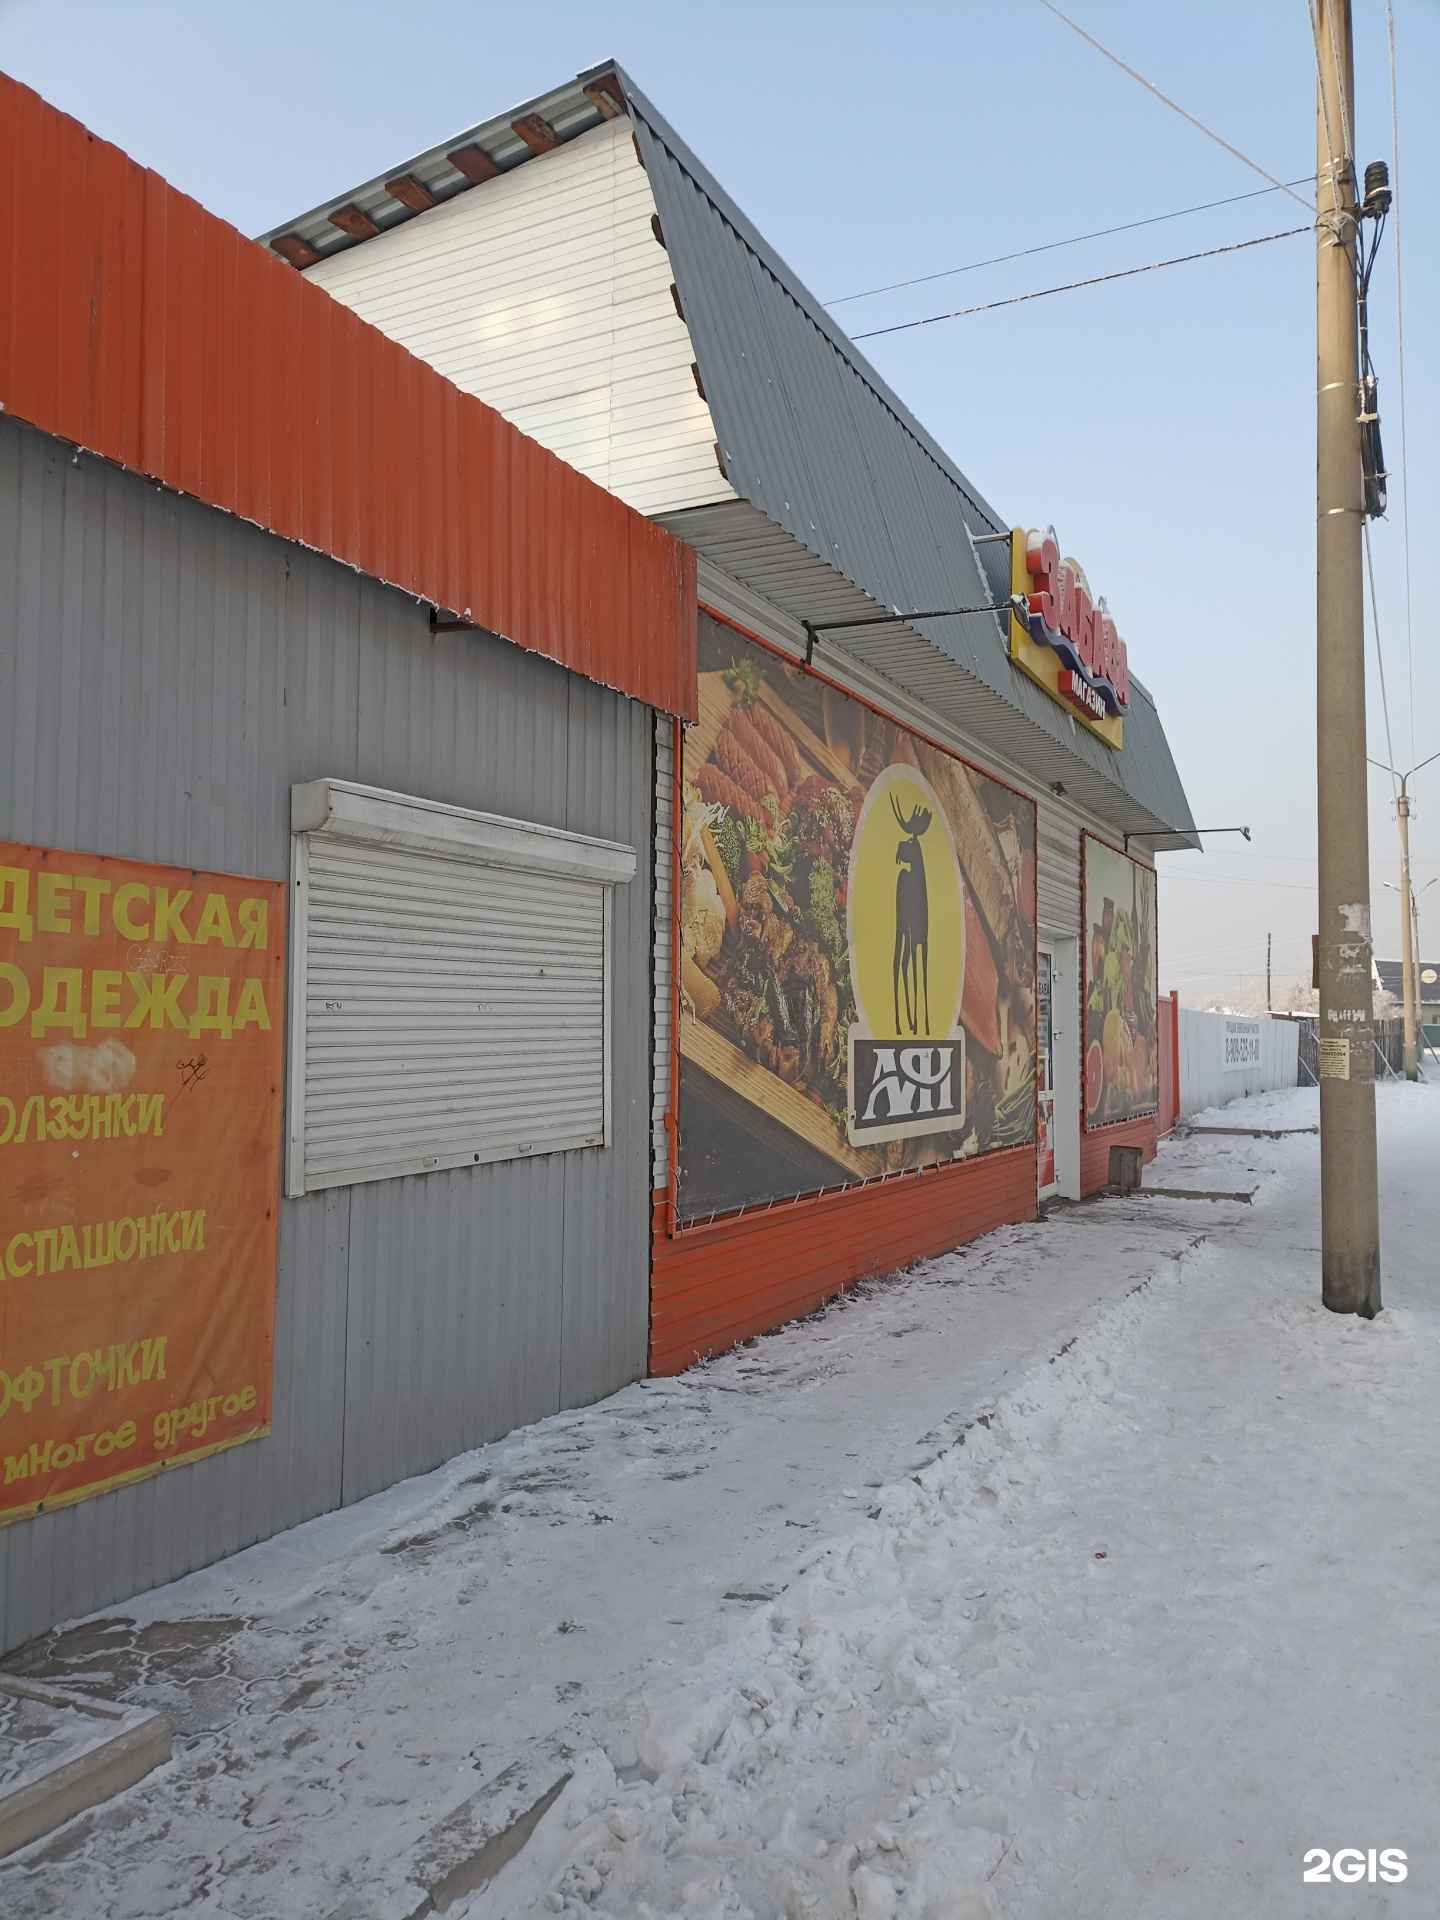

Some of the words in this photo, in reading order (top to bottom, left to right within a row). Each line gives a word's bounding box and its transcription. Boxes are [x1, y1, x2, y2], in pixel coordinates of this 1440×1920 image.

[1071, 670, 1107, 721] МАГАЗИН
[0, 1209, 206, 1281] СПАШОНКИ
[4, 1420, 137, 1485] многое
[152, 1385, 257, 1450] другое
